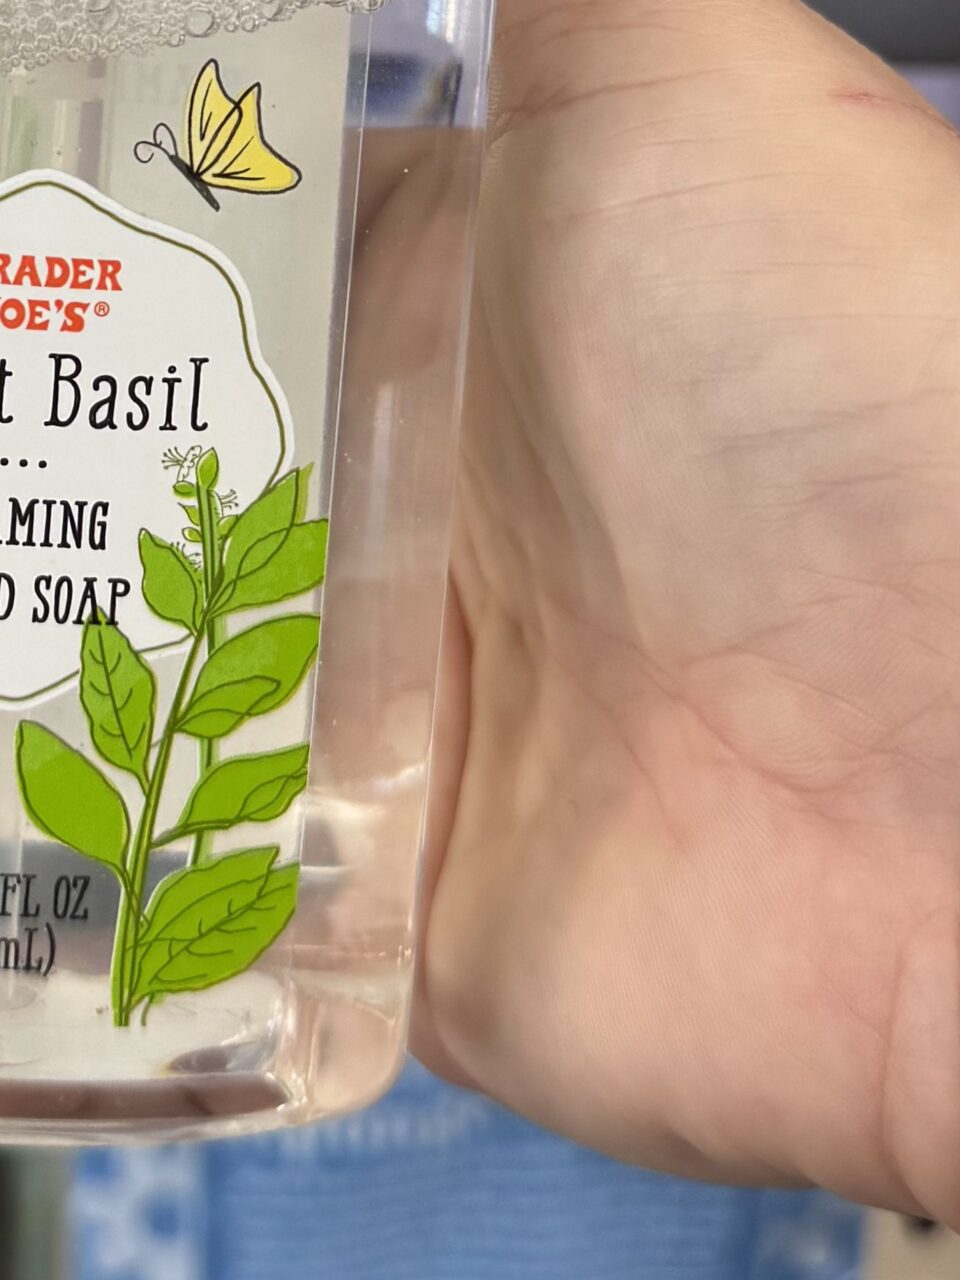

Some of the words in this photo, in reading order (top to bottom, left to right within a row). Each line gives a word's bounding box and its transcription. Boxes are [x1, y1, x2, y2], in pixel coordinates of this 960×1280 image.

[43, 353, 210, 432] Basil
[31, 574, 131, 626] SOAP
[53, 875, 91, 920] OZ
